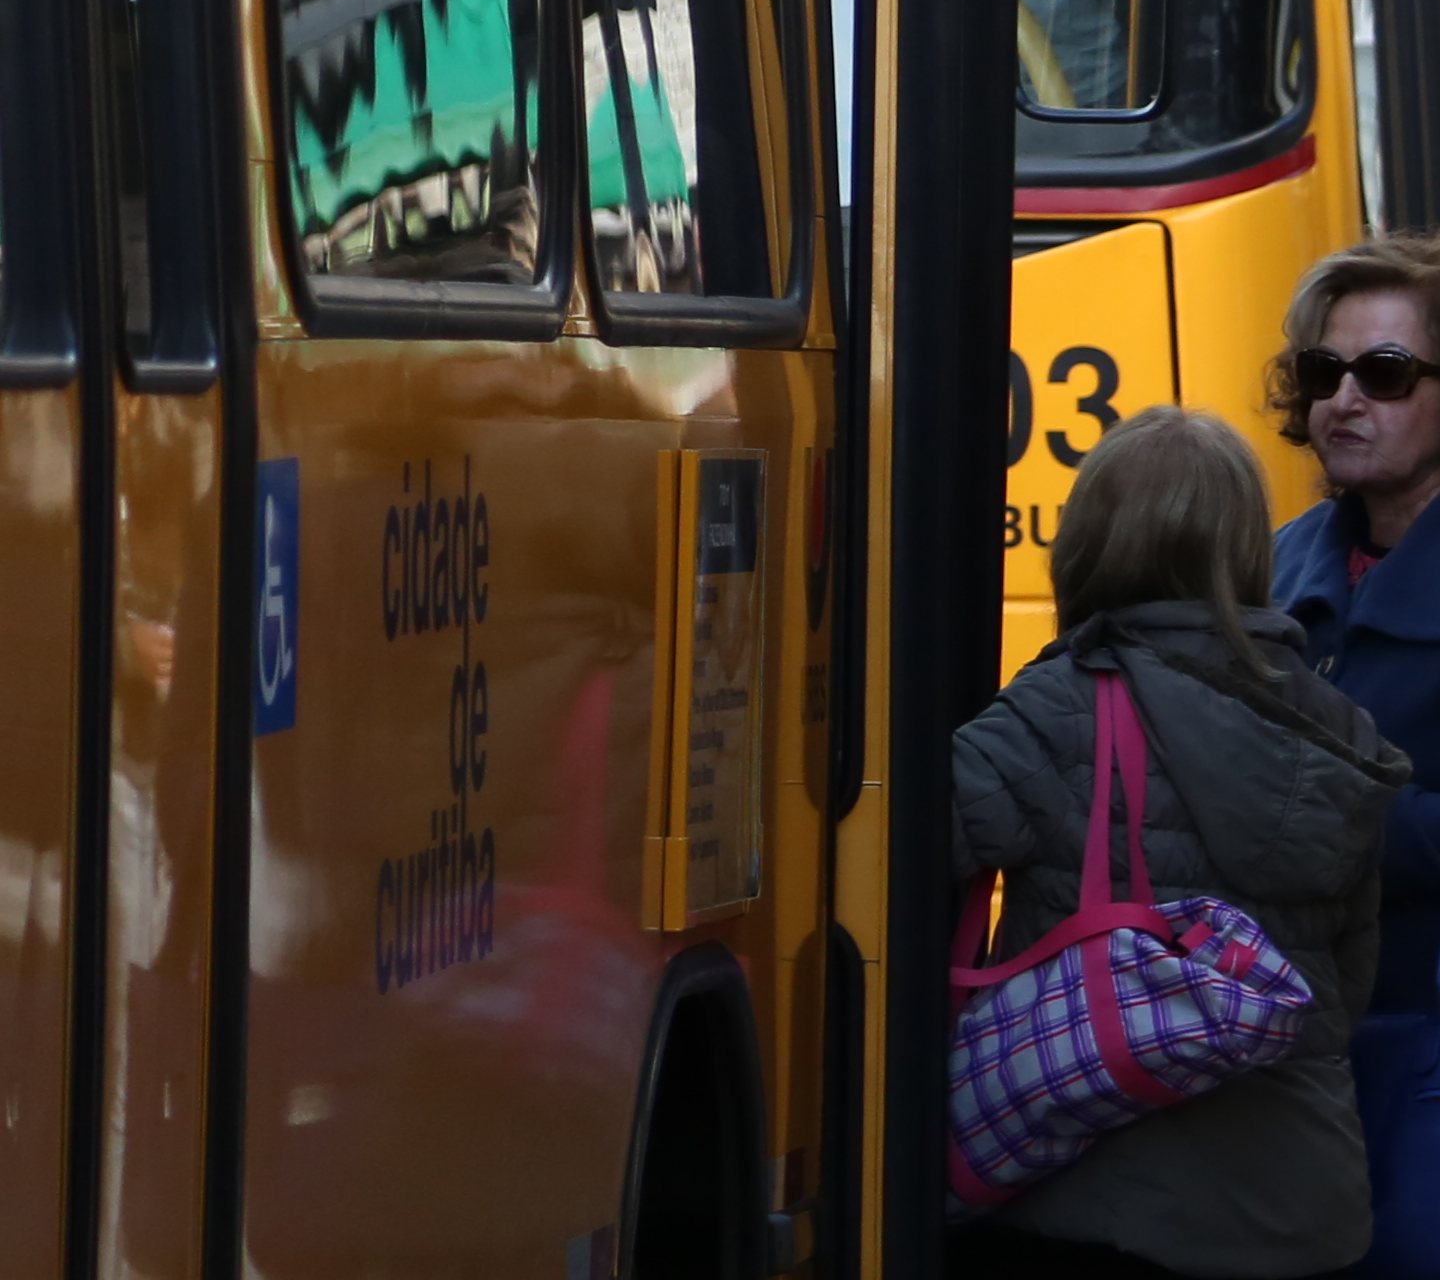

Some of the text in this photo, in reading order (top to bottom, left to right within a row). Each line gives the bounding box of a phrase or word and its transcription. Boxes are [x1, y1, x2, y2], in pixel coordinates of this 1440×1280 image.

[382, 454, 490, 642] cidade
[449, 624, 489, 795] de
[375, 799, 494, 996] curitiba
